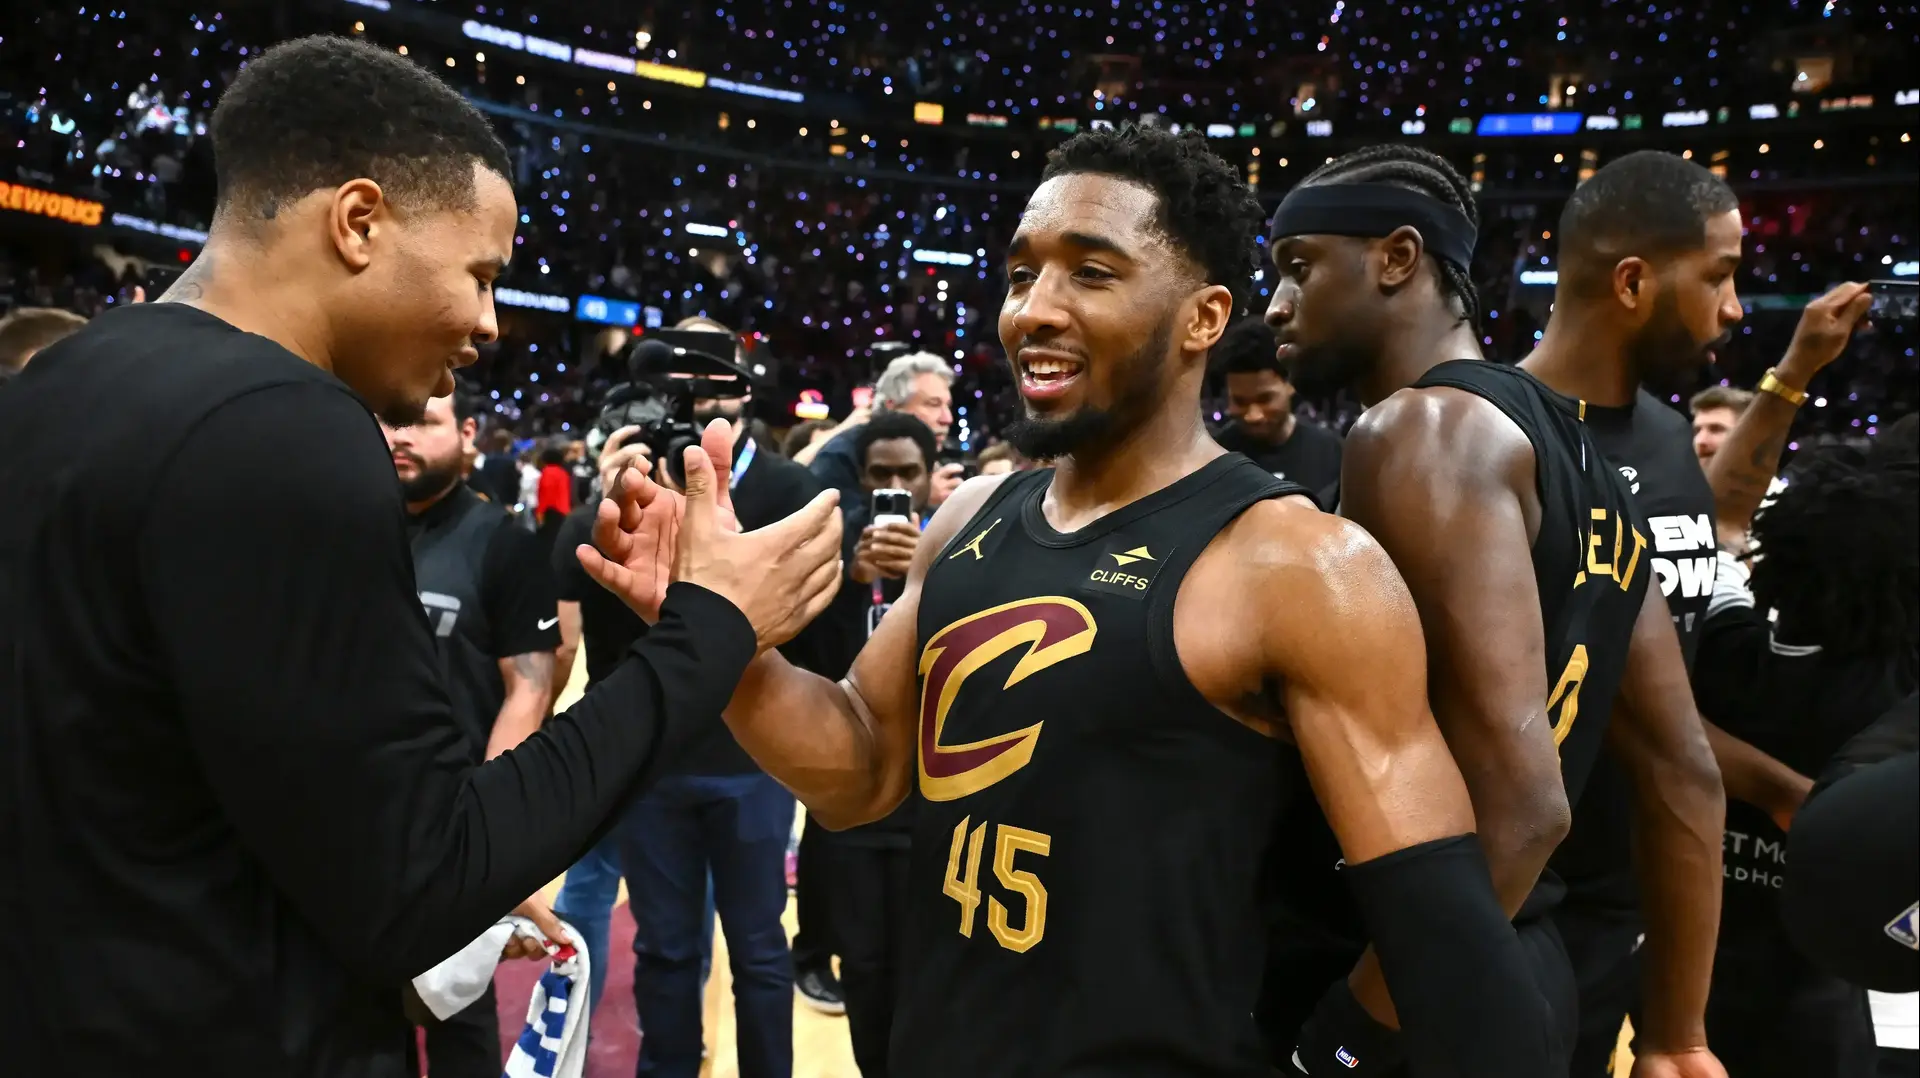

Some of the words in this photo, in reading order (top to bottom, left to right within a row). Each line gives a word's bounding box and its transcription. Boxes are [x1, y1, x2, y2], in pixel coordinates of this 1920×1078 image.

[1090, 569, 1149, 590] CLIFFS
[918, 595, 1098, 802] C
[942, 814, 1051, 954] 45
